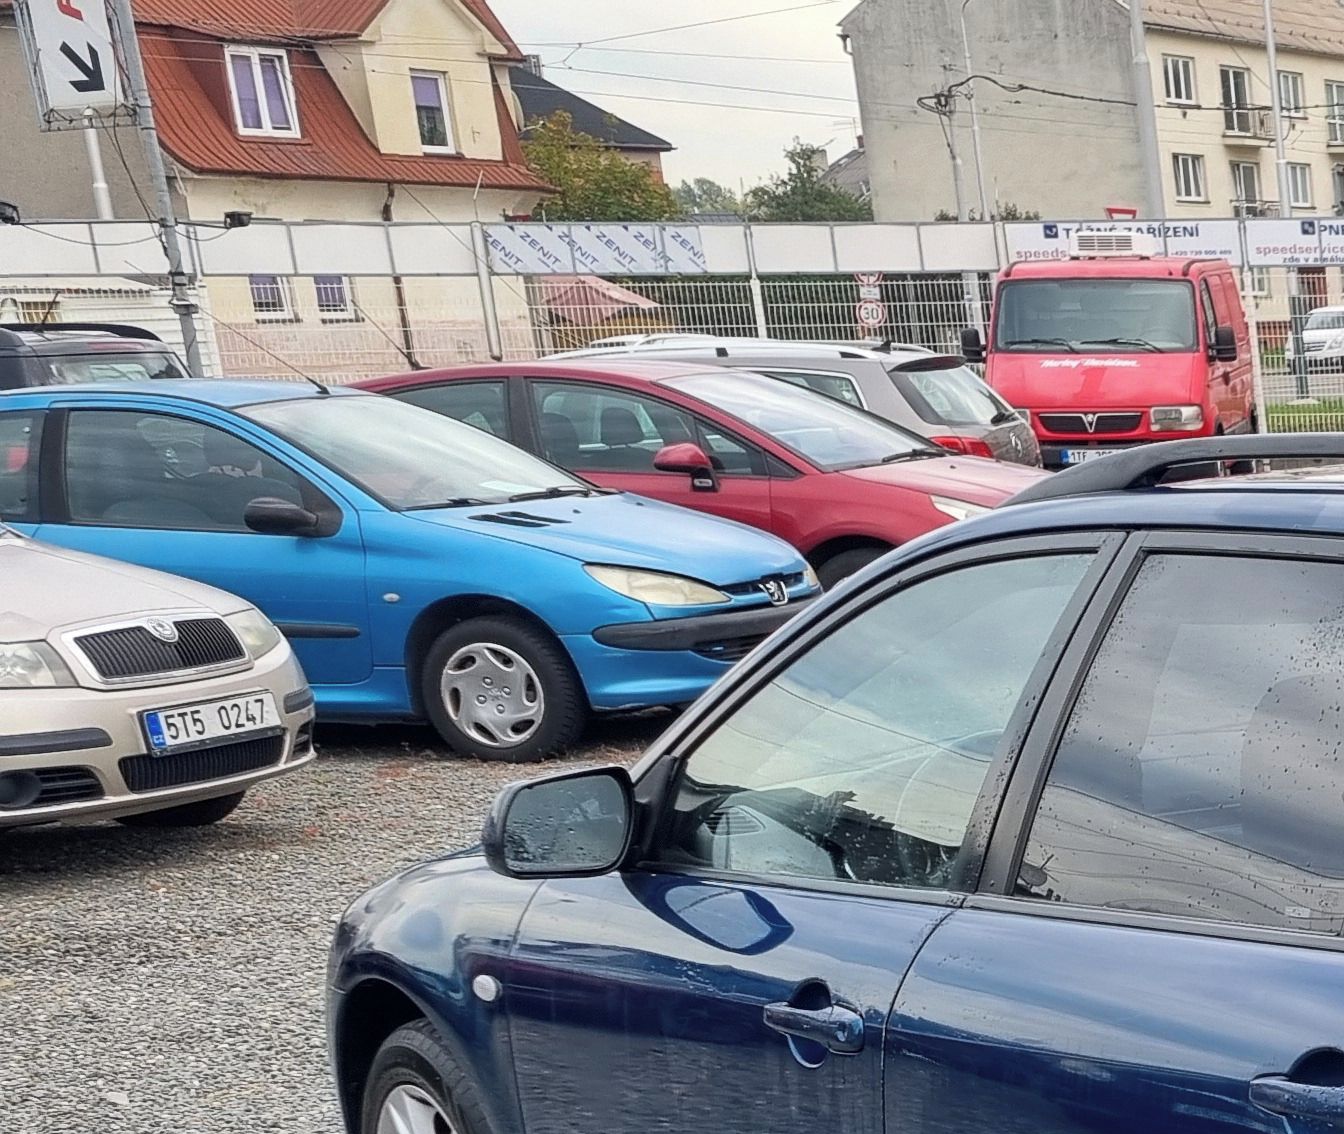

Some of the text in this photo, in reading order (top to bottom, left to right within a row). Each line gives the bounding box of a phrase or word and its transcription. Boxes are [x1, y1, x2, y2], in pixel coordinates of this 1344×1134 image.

[483, 230, 523, 265] ZENIT
[519, 230, 561, 266] ZENIT
[558, 230, 599, 265] ZENIT
[595, 230, 637, 265] ZENIT
[1283, 256, 1300, 264] zde
[863, 306, 879, 320] 30
[164, 698, 265, 740] 5T5 0247
